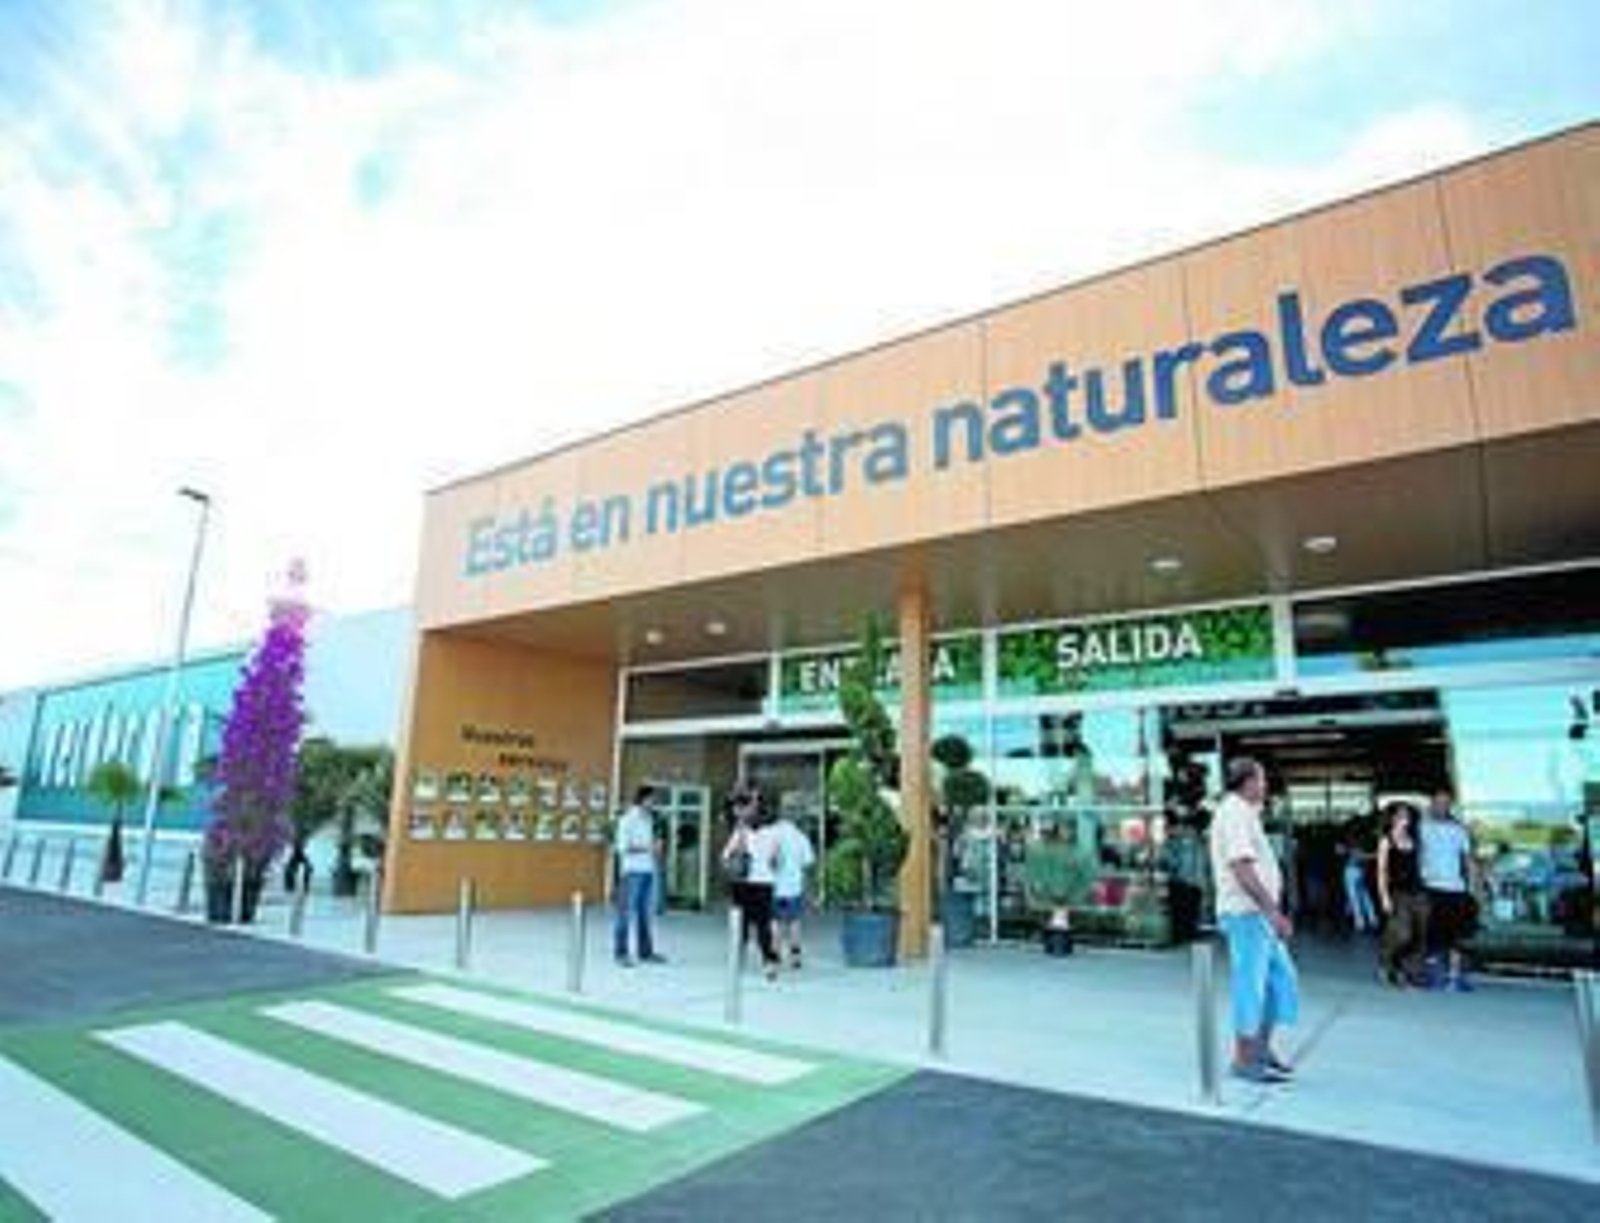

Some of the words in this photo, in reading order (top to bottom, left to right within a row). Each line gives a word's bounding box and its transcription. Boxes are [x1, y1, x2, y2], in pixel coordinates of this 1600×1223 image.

[464, 495, 557, 576] Está
[572, 495, 630, 551] en
[646, 421, 908, 534] nuestra
[933, 254, 1576, 470] naturaleza
[800, 646, 955, 692] ENAA
[1056, 622, 1203, 669] SALIDA
